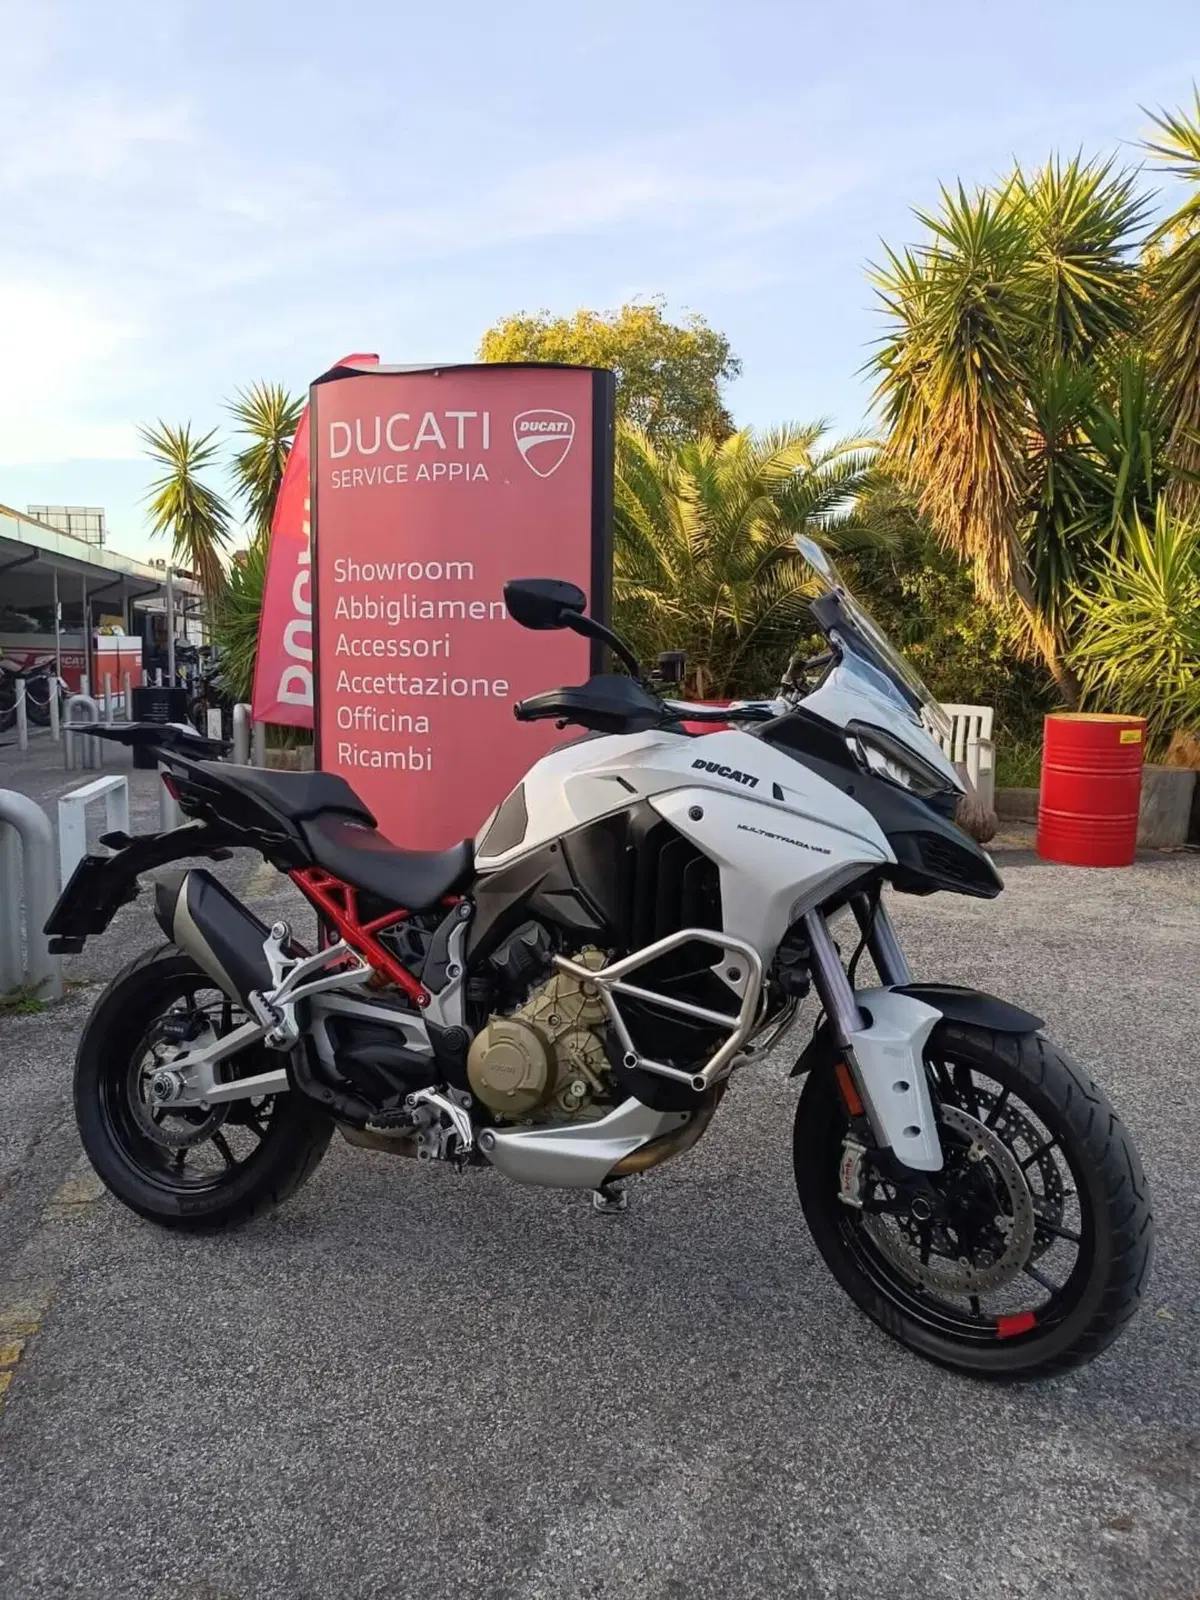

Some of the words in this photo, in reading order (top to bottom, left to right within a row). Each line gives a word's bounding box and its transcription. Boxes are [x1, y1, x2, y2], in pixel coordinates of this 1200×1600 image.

[329, 411, 490, 459] DUCATI
[519, 420, 569, 433] DUCATI
[331, 464, 409, 489] SERVICE
[415, 462, 490, 482] APPIA
[334, 556, 475, 583] Showroom
[334, 593, 508, 626] Abbigliamen
[335, 632, 451, 658] Accessori
[336, 669, 510, 697] Accettazione
[337, 705, 430, 733] Officina
[338, 742, 433, 771] Ricambi
[691, 759, 760, 788] DUCATI
[737, 824, 810, 849] MULTISTRADA
